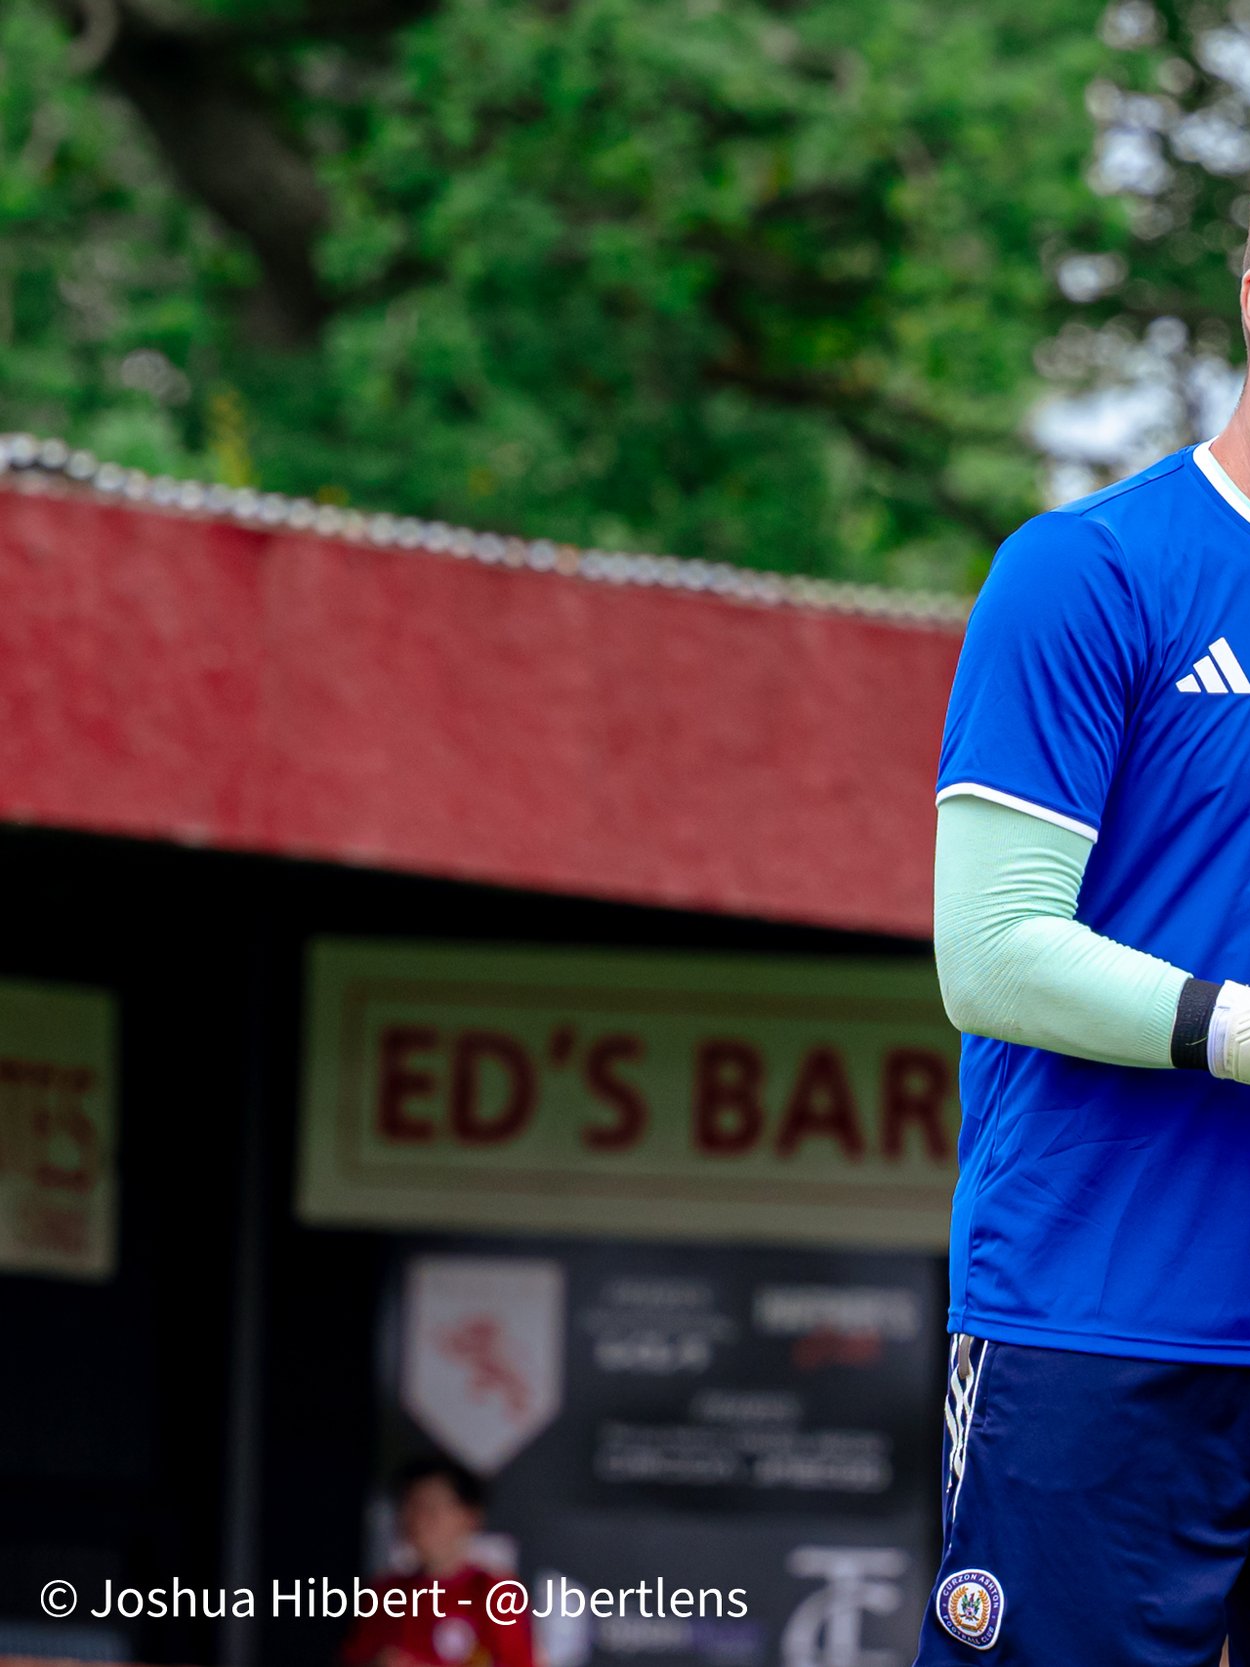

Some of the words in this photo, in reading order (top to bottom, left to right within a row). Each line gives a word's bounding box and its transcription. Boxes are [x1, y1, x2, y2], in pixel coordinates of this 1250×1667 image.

[692, 1036, 953, 1164] BAR
[942, 1573, 977, 1597] CURZON
[978, 1575, 1001, 1609] ASHTON
[981, 1625, 995, 1643] CLUB
